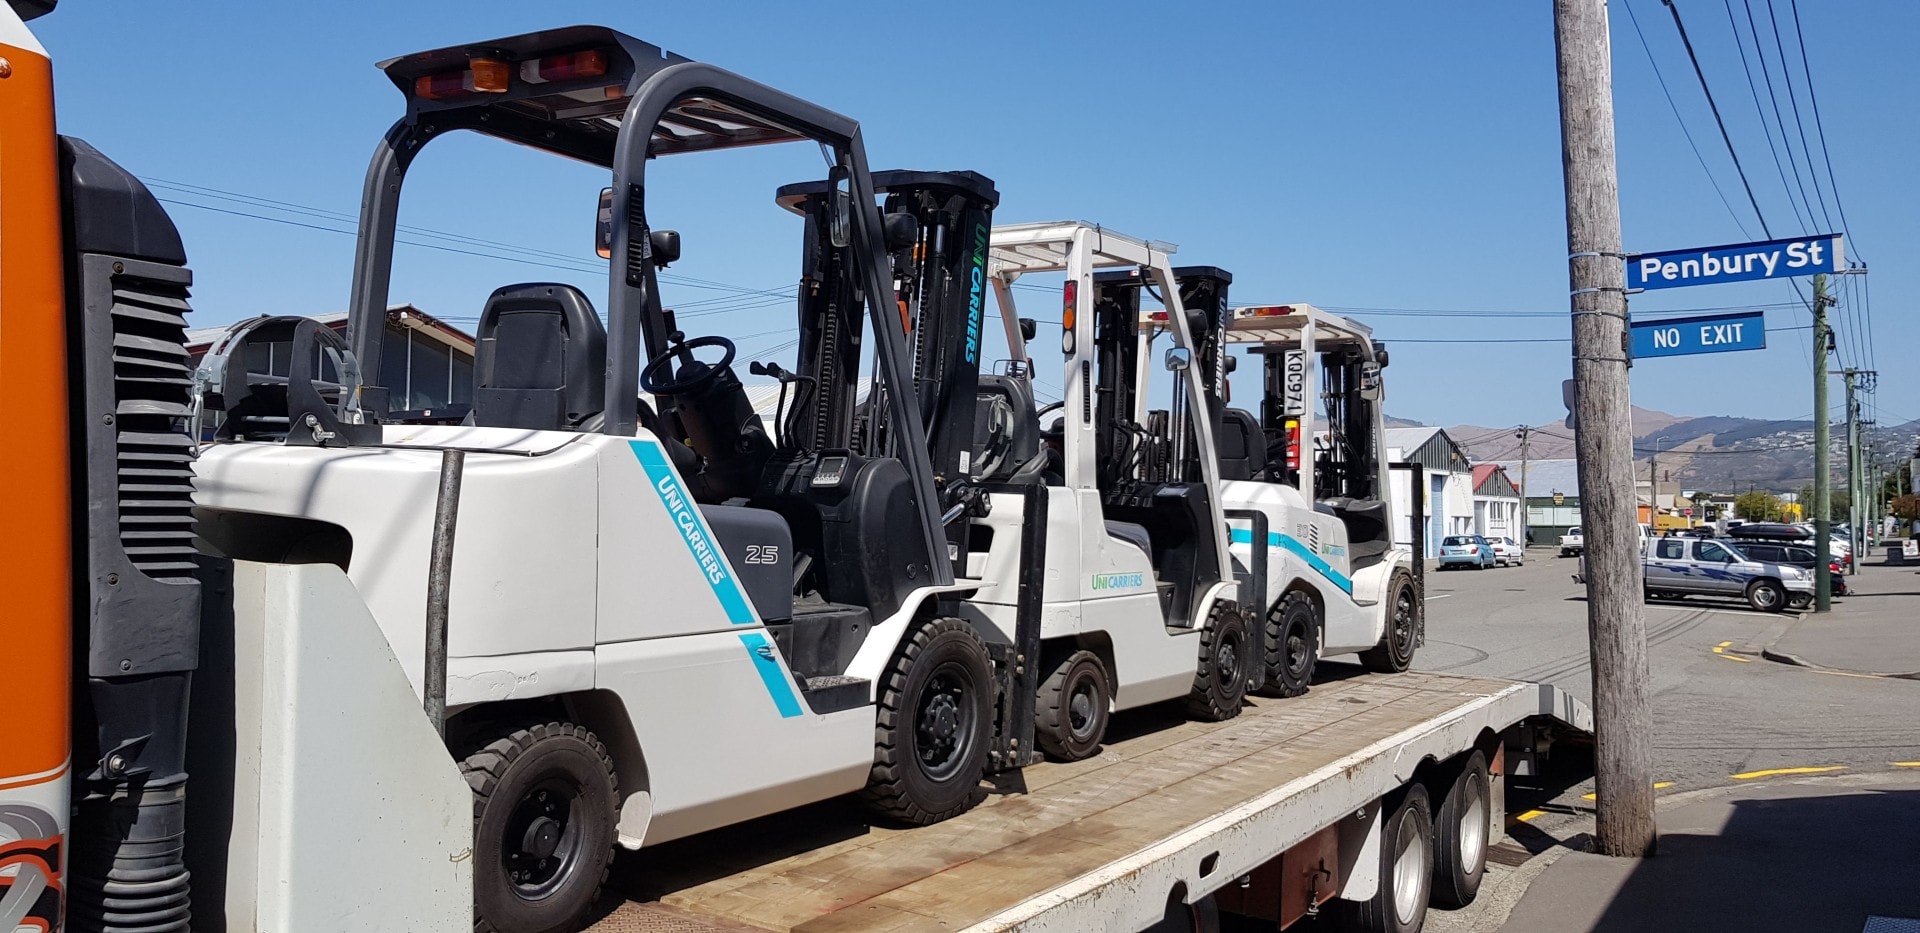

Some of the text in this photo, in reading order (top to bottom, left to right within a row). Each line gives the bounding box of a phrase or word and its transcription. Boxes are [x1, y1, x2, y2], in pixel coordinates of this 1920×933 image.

[1641, 240, 1823, 283] Penbury St
[966, 222, 987, 366] UNICARRIERS
[1653, 323, 1743, 349] NO EXIT
[1287, 352, 1303, 411] KQC971
[657, 475, 726, 586] UNICARRIERS
[744, 545, 779, 565] 25
